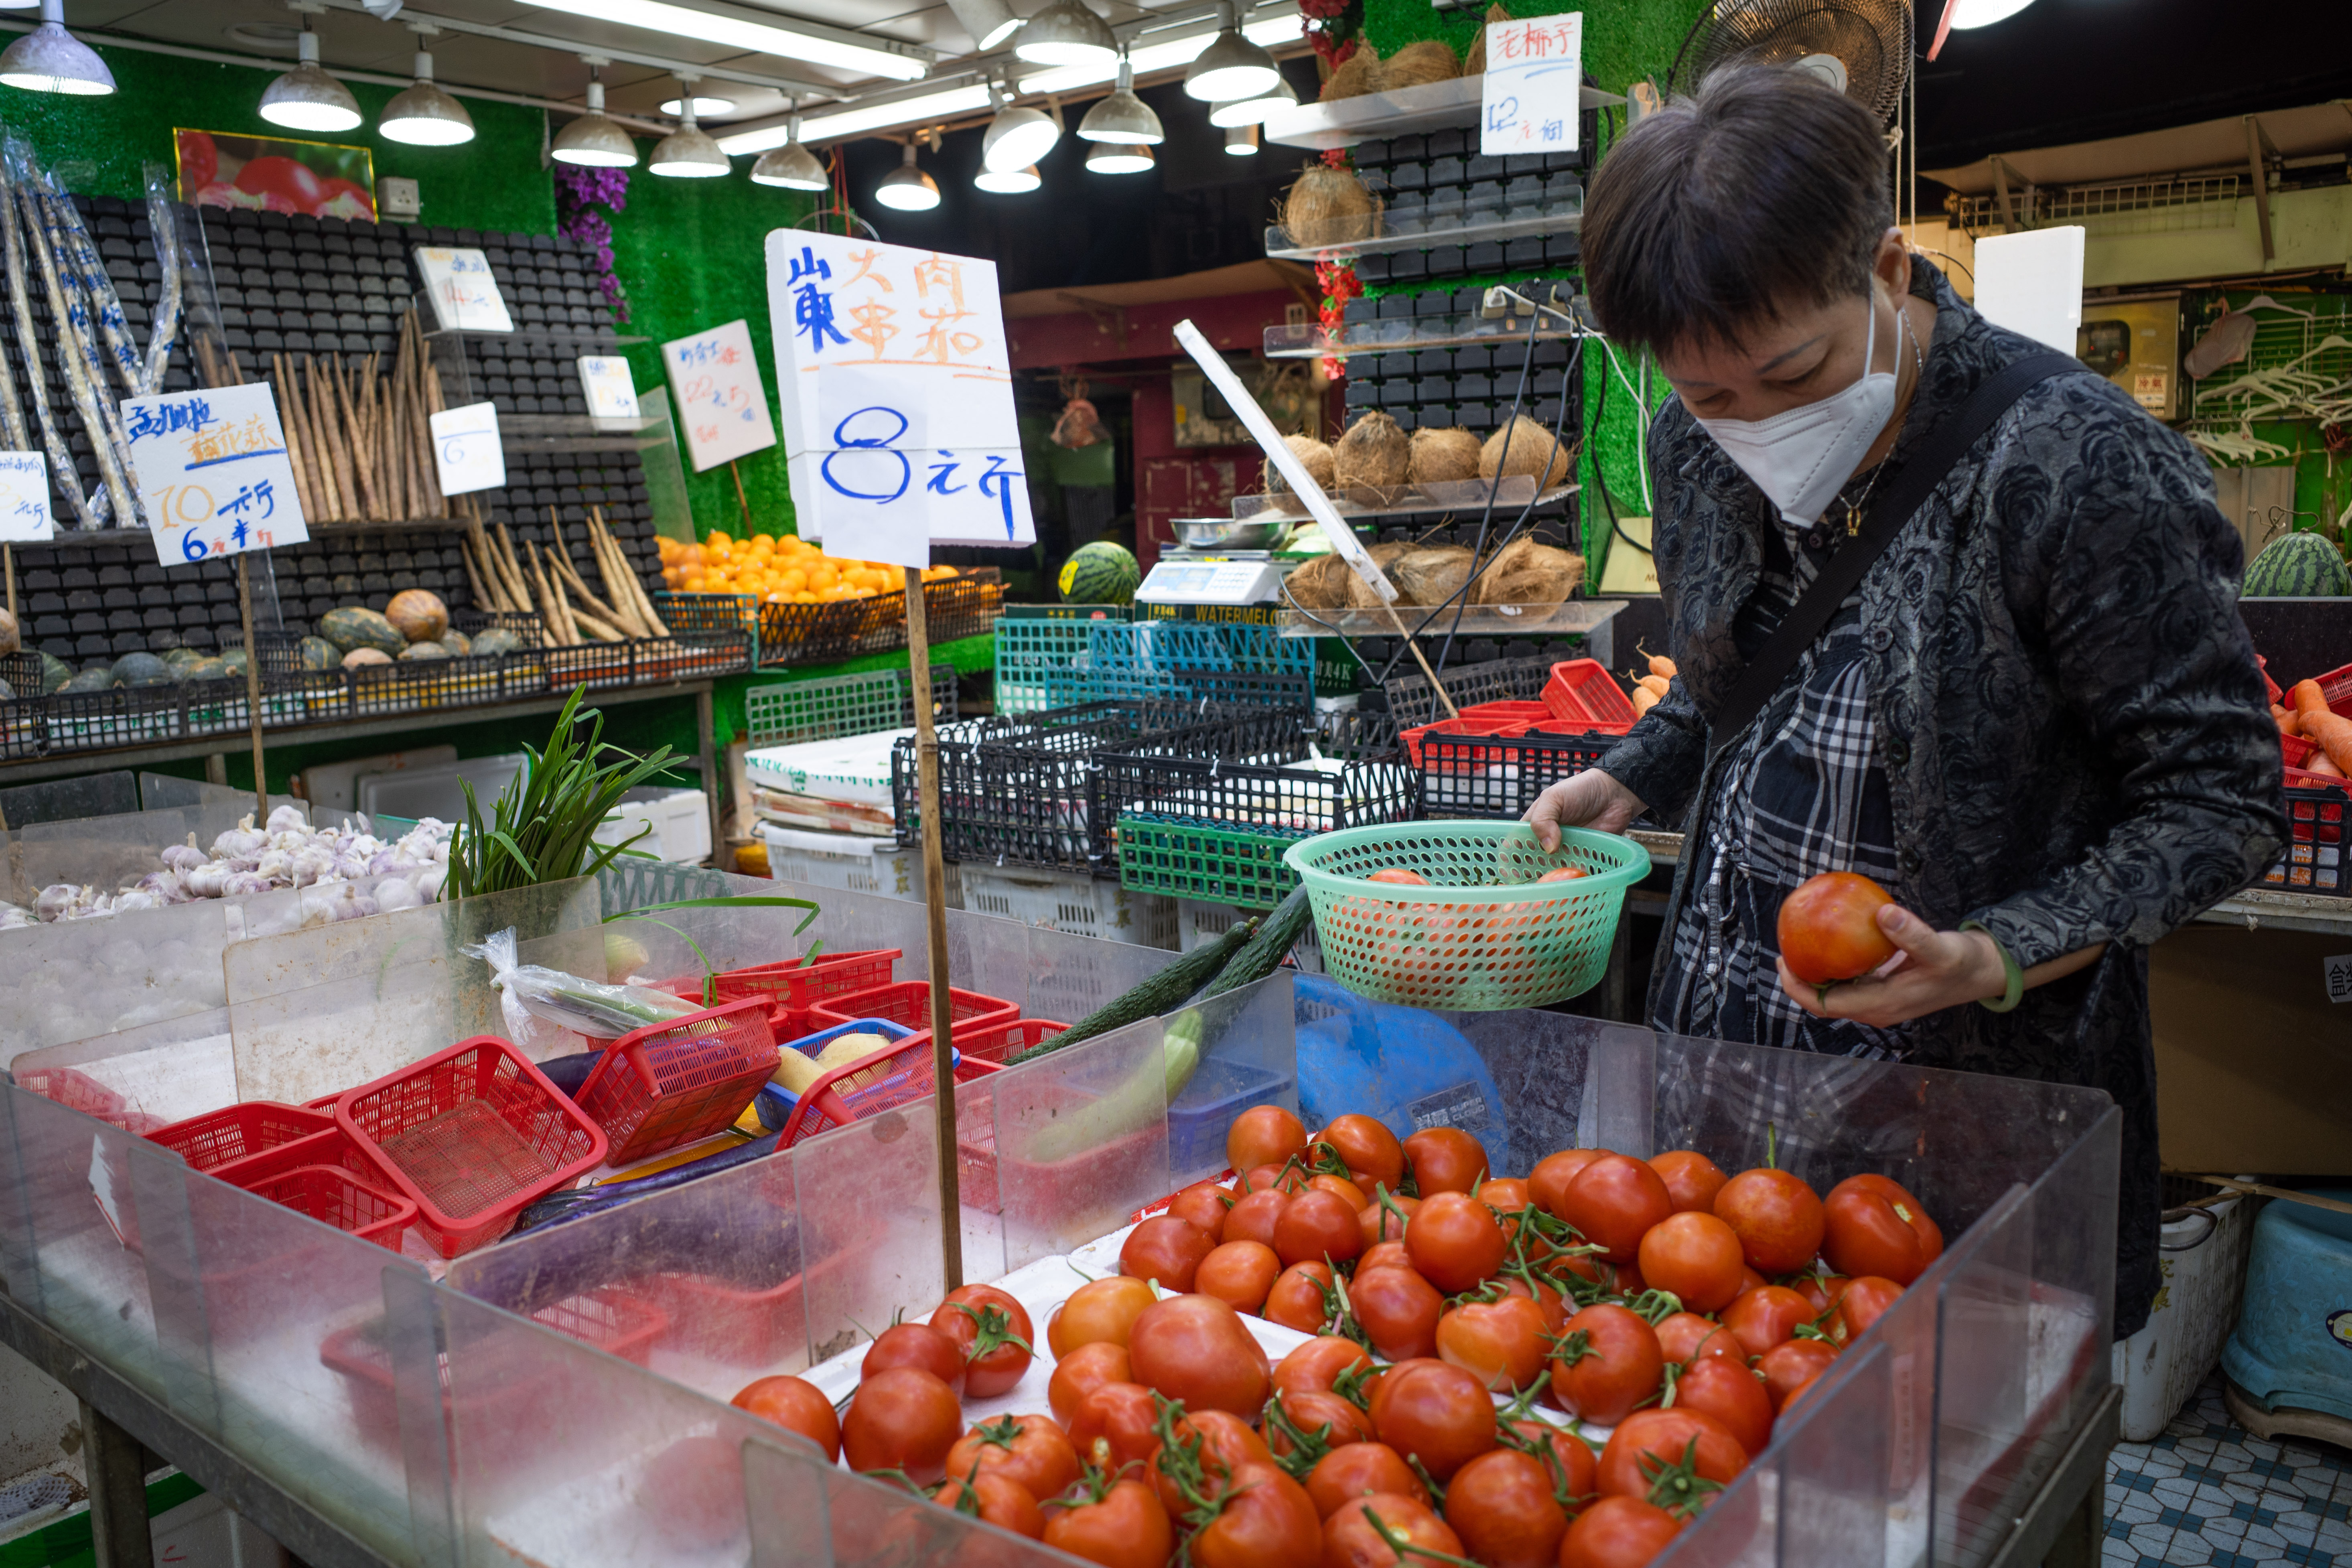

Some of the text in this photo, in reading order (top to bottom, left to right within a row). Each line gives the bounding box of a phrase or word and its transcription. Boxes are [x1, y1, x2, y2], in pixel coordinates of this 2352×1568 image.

[1493, 22, 1574, 62] 老椰子
[787, 247, 852, 353] 山東
